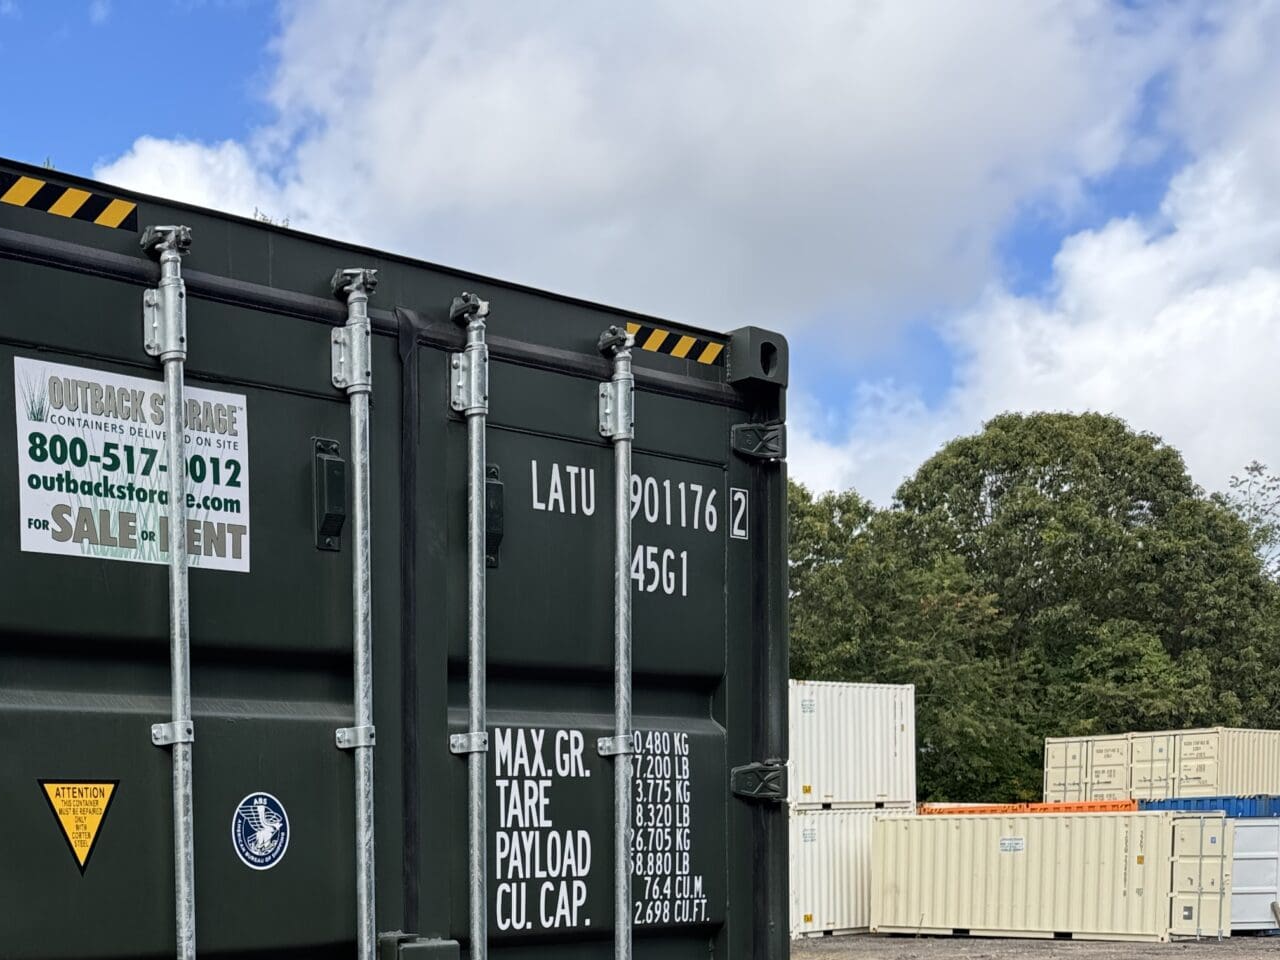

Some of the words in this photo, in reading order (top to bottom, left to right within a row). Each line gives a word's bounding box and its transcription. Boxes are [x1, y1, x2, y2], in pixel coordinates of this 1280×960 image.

[48, 376, 146, 423] OUTBACK
[150, 393, 238, 436] SRAGE
[50, 414, 125, 435] CONTAINERS
[129, 427, 191, 444] DELIVED
[196, 437, 212, 447] ON
[217, 439, 239, 451] SITE
[28, 431, 241, 488] 800-517-012
[28, 470, 241, 514] outbackstorae.com
[531, 459, 595, 516] LATU
[631, 473, 717, 532] 901176
[731, 490, 747, 538] 2
[28, 518, 49, 530] FOR
[51, 503, 137, 549] SALE
[141, 530, 156, 541] OR
[631, 544, 687, 597] 45G1
[633, 730, 670, 755] 0,480
[674, 732, 689, 755] KG
[675, 756, 690, 779] LB
[55, 787, 105, 798] ATTENTION
[72, 799, 98, 807] CONTAINER
[253, 797, 268, 805] ABS
[495, 779, 552, 828] TARE
[676, 781, 690, 803] KG
[59, 807, 71, 815] MUST
[79, 807, 102, 815] REPAIRED
[74, 815, 87, 823] ONLY
[676, 804, 690, 827] LB
[74, 839, 88, 848] STEEL
[676, 828, 690, 851] KG
[495, 830, 592, 879] PAYLOAD
[676, 852, 690, 875] LB
[644, 876, 671, 899] 76.4
[675, 875, 706, 898] CU.M.
[495, 882, 532, 930] CU.
[540, 880, 591, 928] CAP.
[674, 899, 710, 922] CU.FT.
